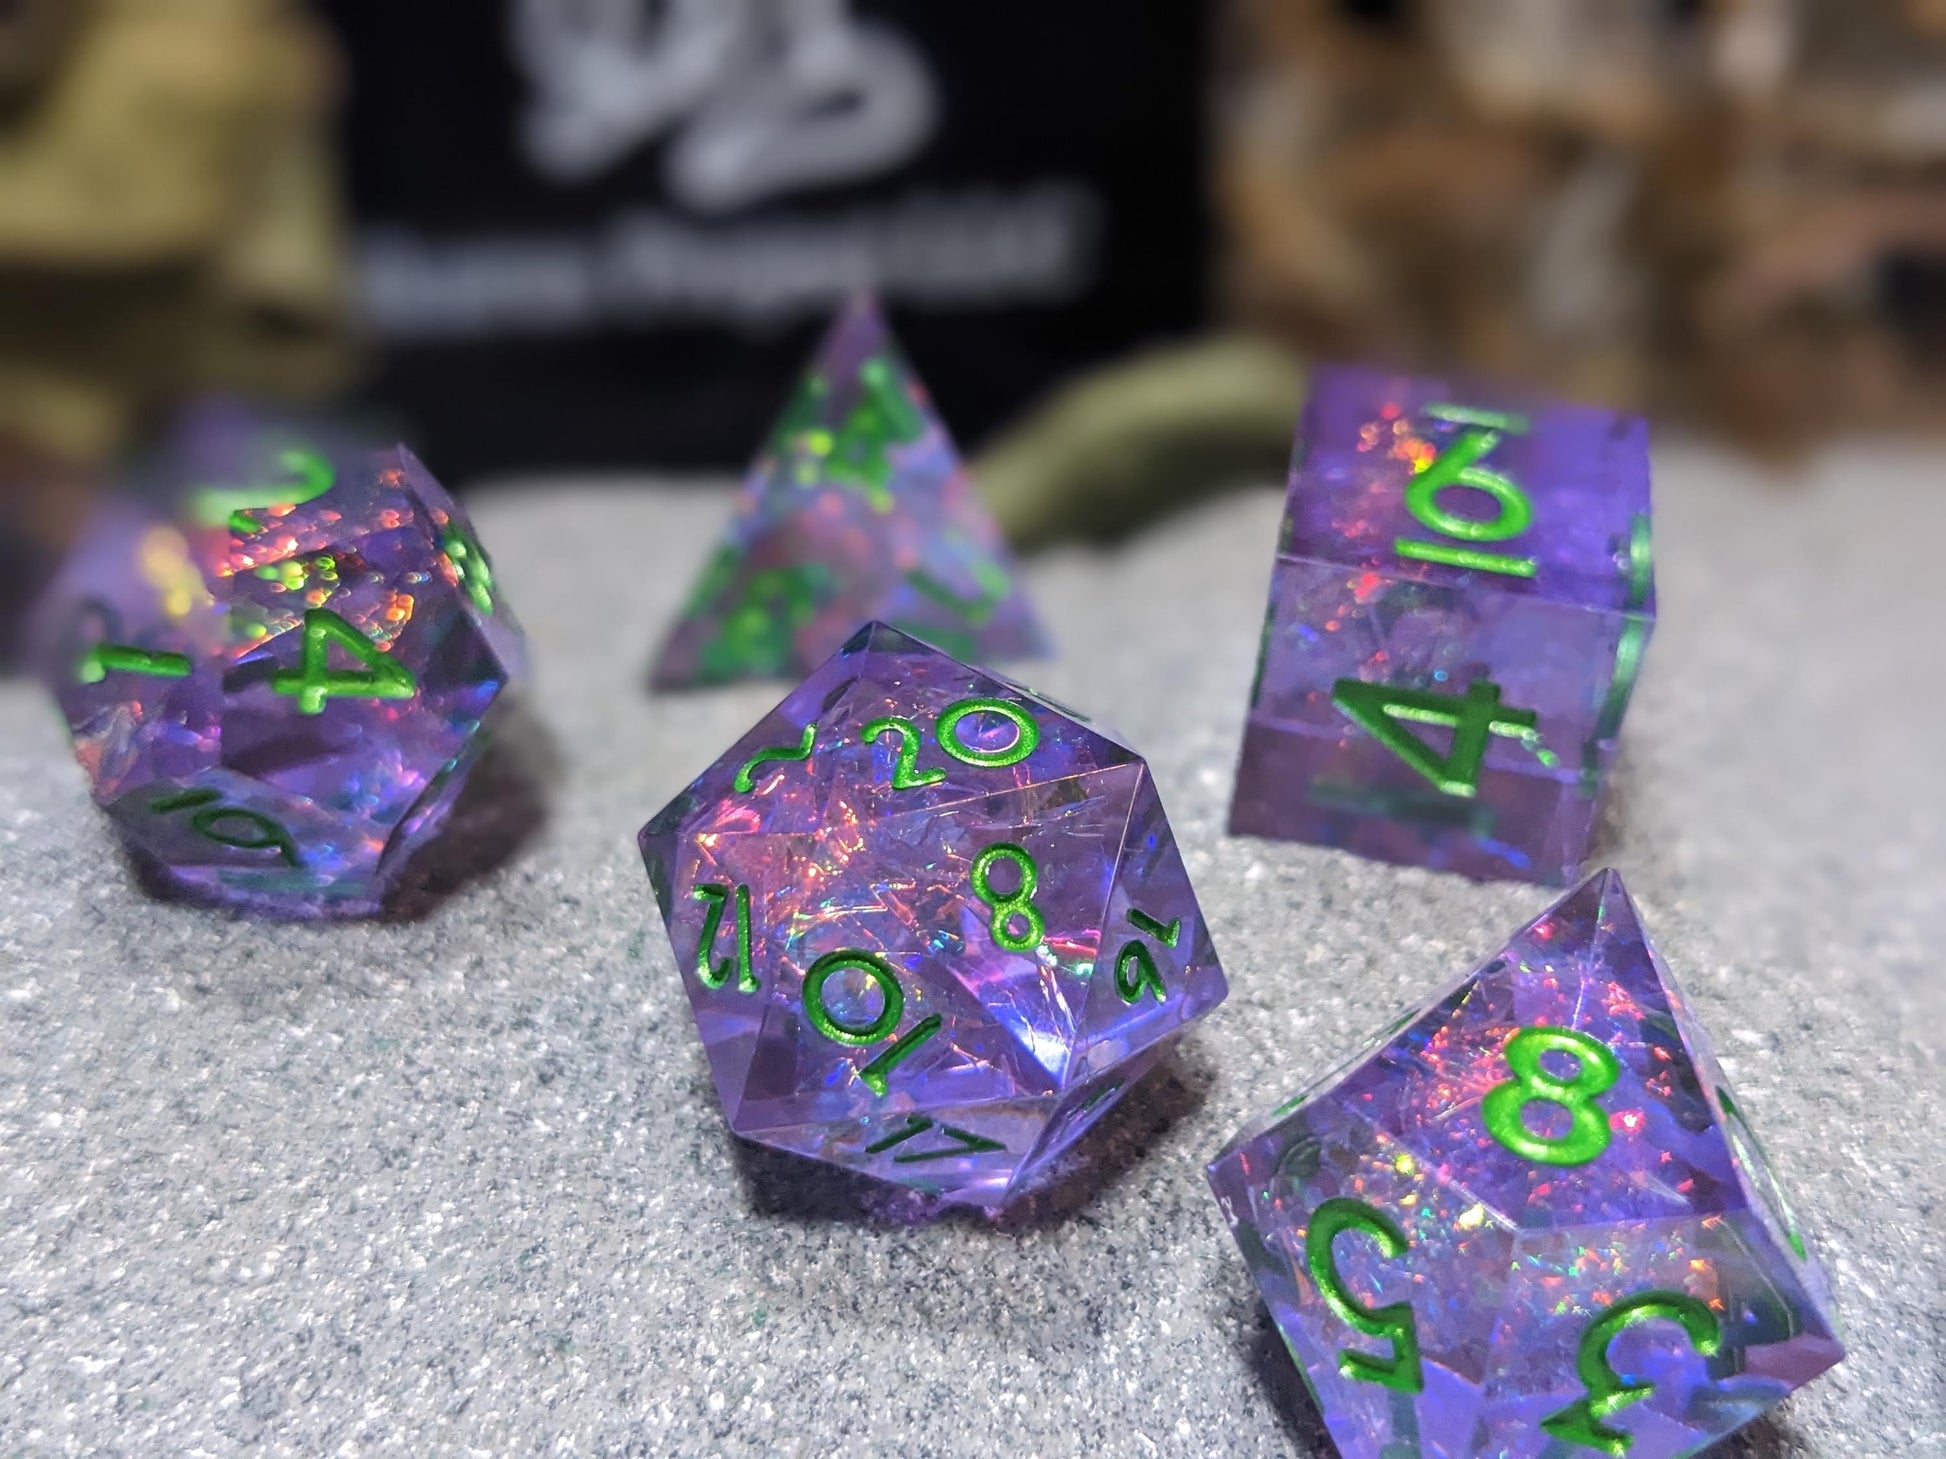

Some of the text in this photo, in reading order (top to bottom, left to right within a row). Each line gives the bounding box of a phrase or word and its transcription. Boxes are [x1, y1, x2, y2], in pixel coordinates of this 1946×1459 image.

[272, 608, 415, 714] 4
[861, 698, 1039, 790] 20
[1331, 677, 1538, 798] 4
[970, 842, 1045, 952] 8
[802, 949, 942, 1096] 10
[1482, 1026, 1620, 1166] 8
[1306, 1197, 1425, 1393] 5
[1540, 1291, 1722, 1456] 3
